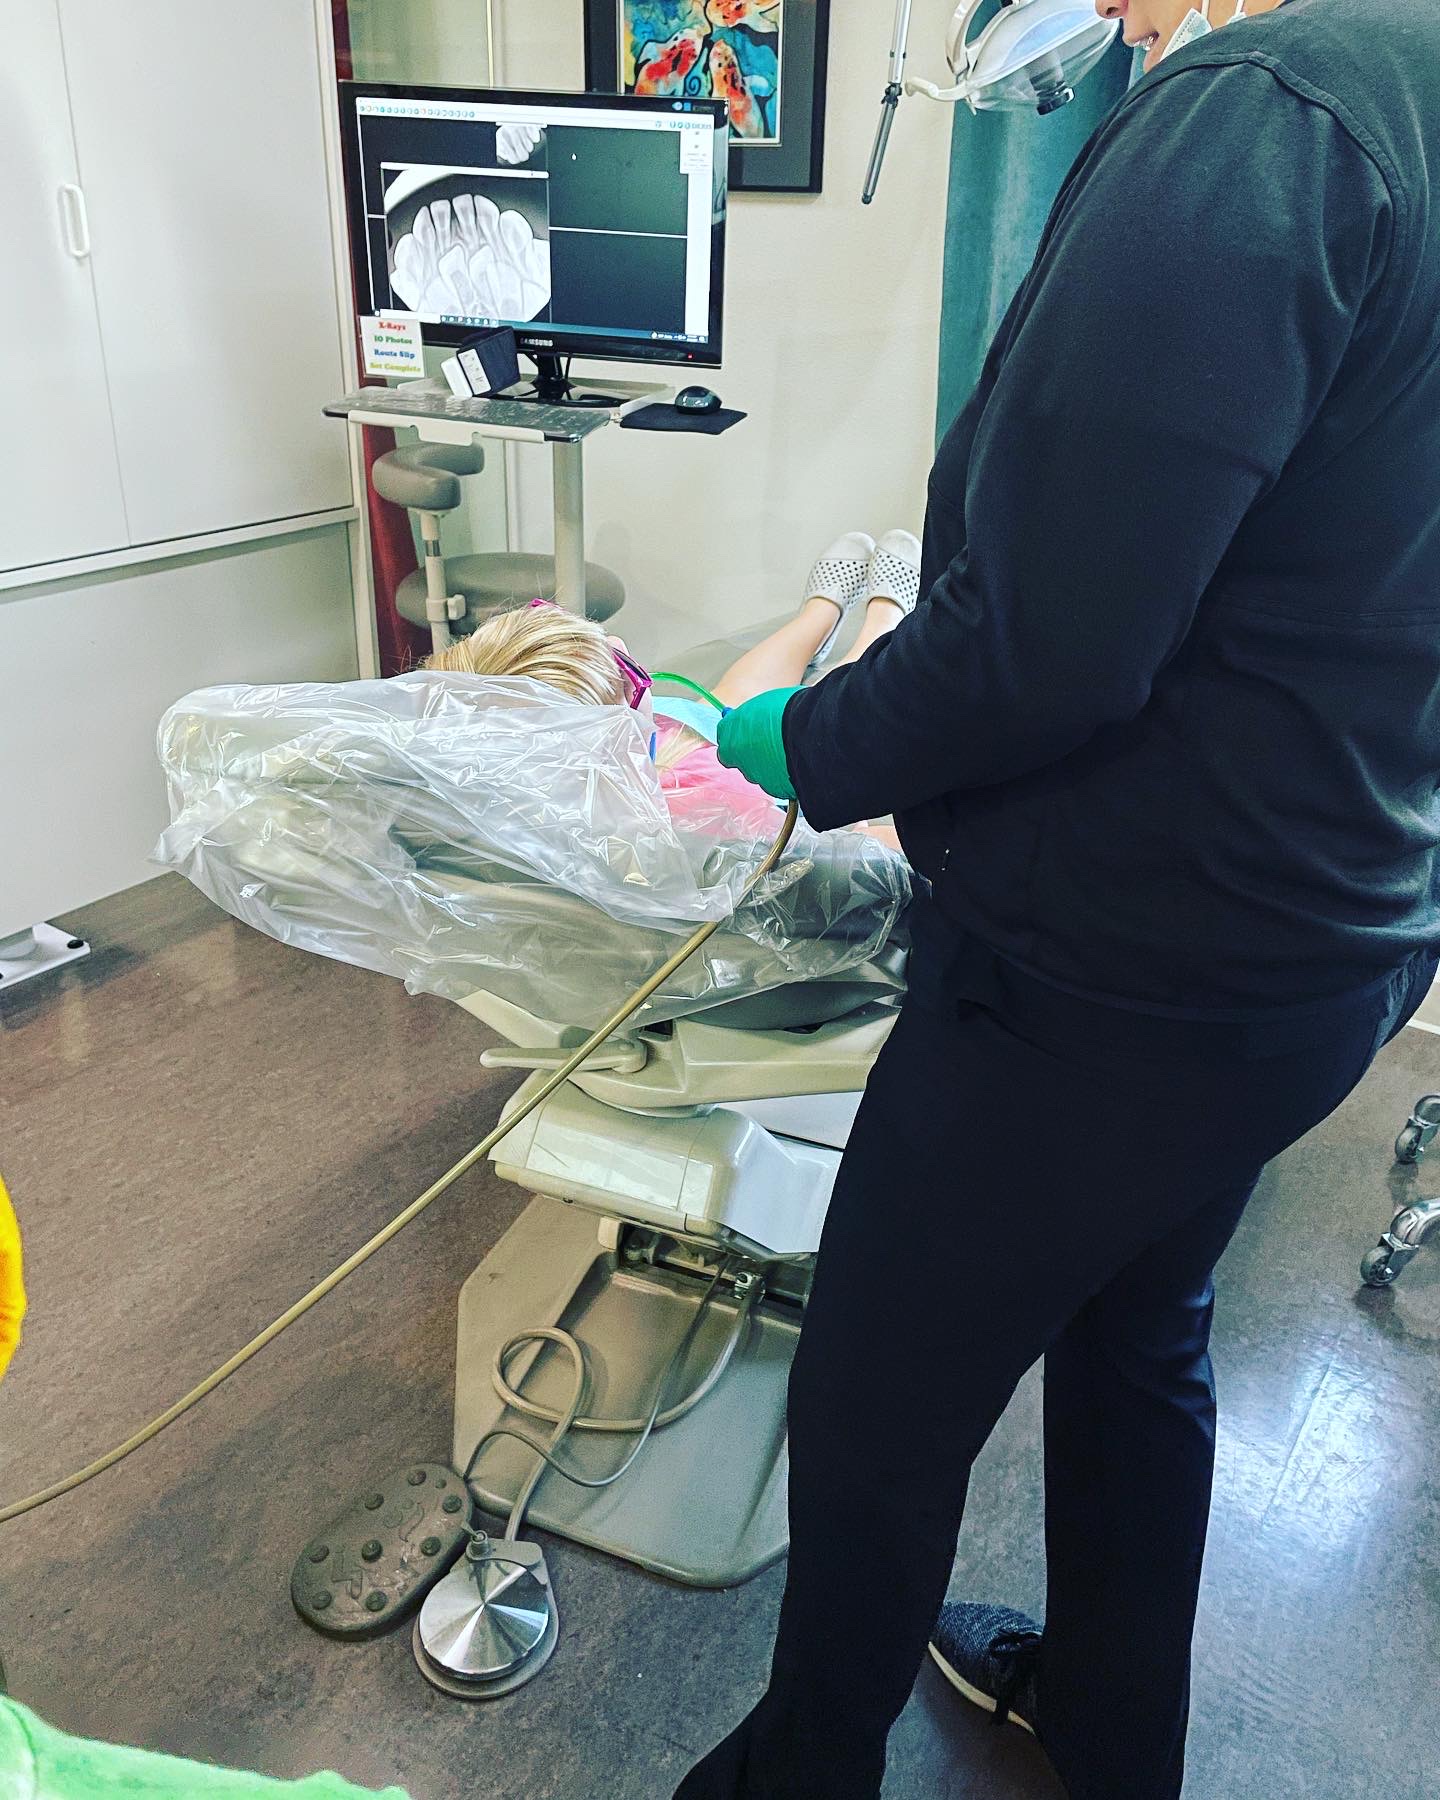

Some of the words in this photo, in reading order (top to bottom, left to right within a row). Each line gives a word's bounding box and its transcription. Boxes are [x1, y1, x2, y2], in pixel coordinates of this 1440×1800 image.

[379, 321, 406, 331] X-Rays
[386, 336, 412, 344] Photos
[374, 349, 397, 357] Route
[399, 351, 415, 359] Slip
[385, 363, 421, 372] Complete
